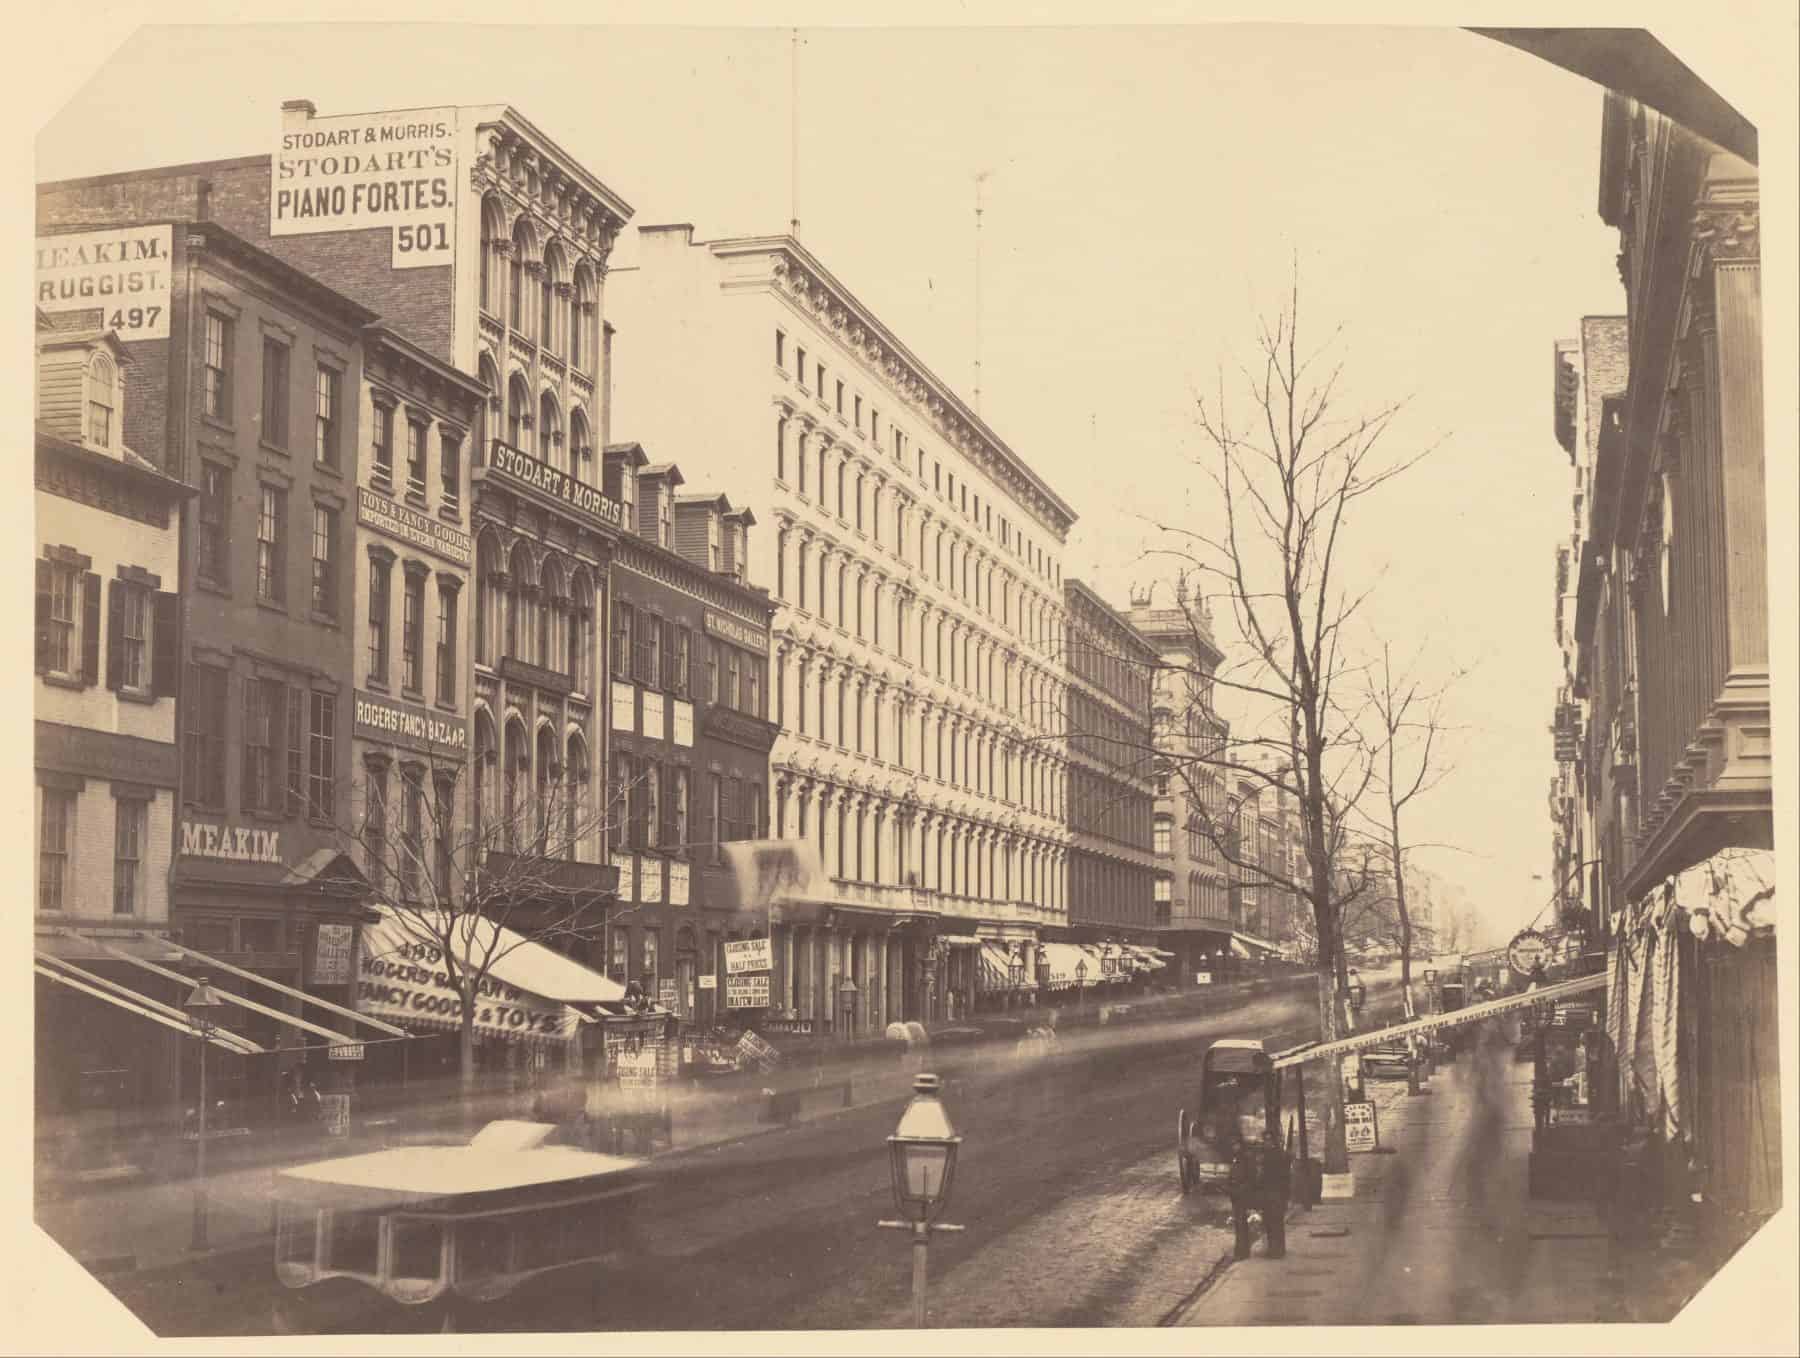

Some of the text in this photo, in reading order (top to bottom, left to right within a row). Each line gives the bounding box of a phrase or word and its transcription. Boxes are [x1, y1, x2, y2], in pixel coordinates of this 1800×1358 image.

[282, 129, 361, 150] STODART
[364, 127, 377, 143] &
[279, 145, 452, 180] STODART'S
[277, 177, 453, 219] PIANO FORTES.
[397, 223, 450, 252] 501
[109, 306, 162, 330] 497
[496, 446, 561, 495] STODART
[562, 478, 570, 500] &
[362, 491, 388, 514] TOYS
[399, 508, 431, 533] FANCY
[400, 712, 426, 738] FANCY
[358, 982, 413, 1008] FANCY
[496, 1006, 559, 1033] TOYS
